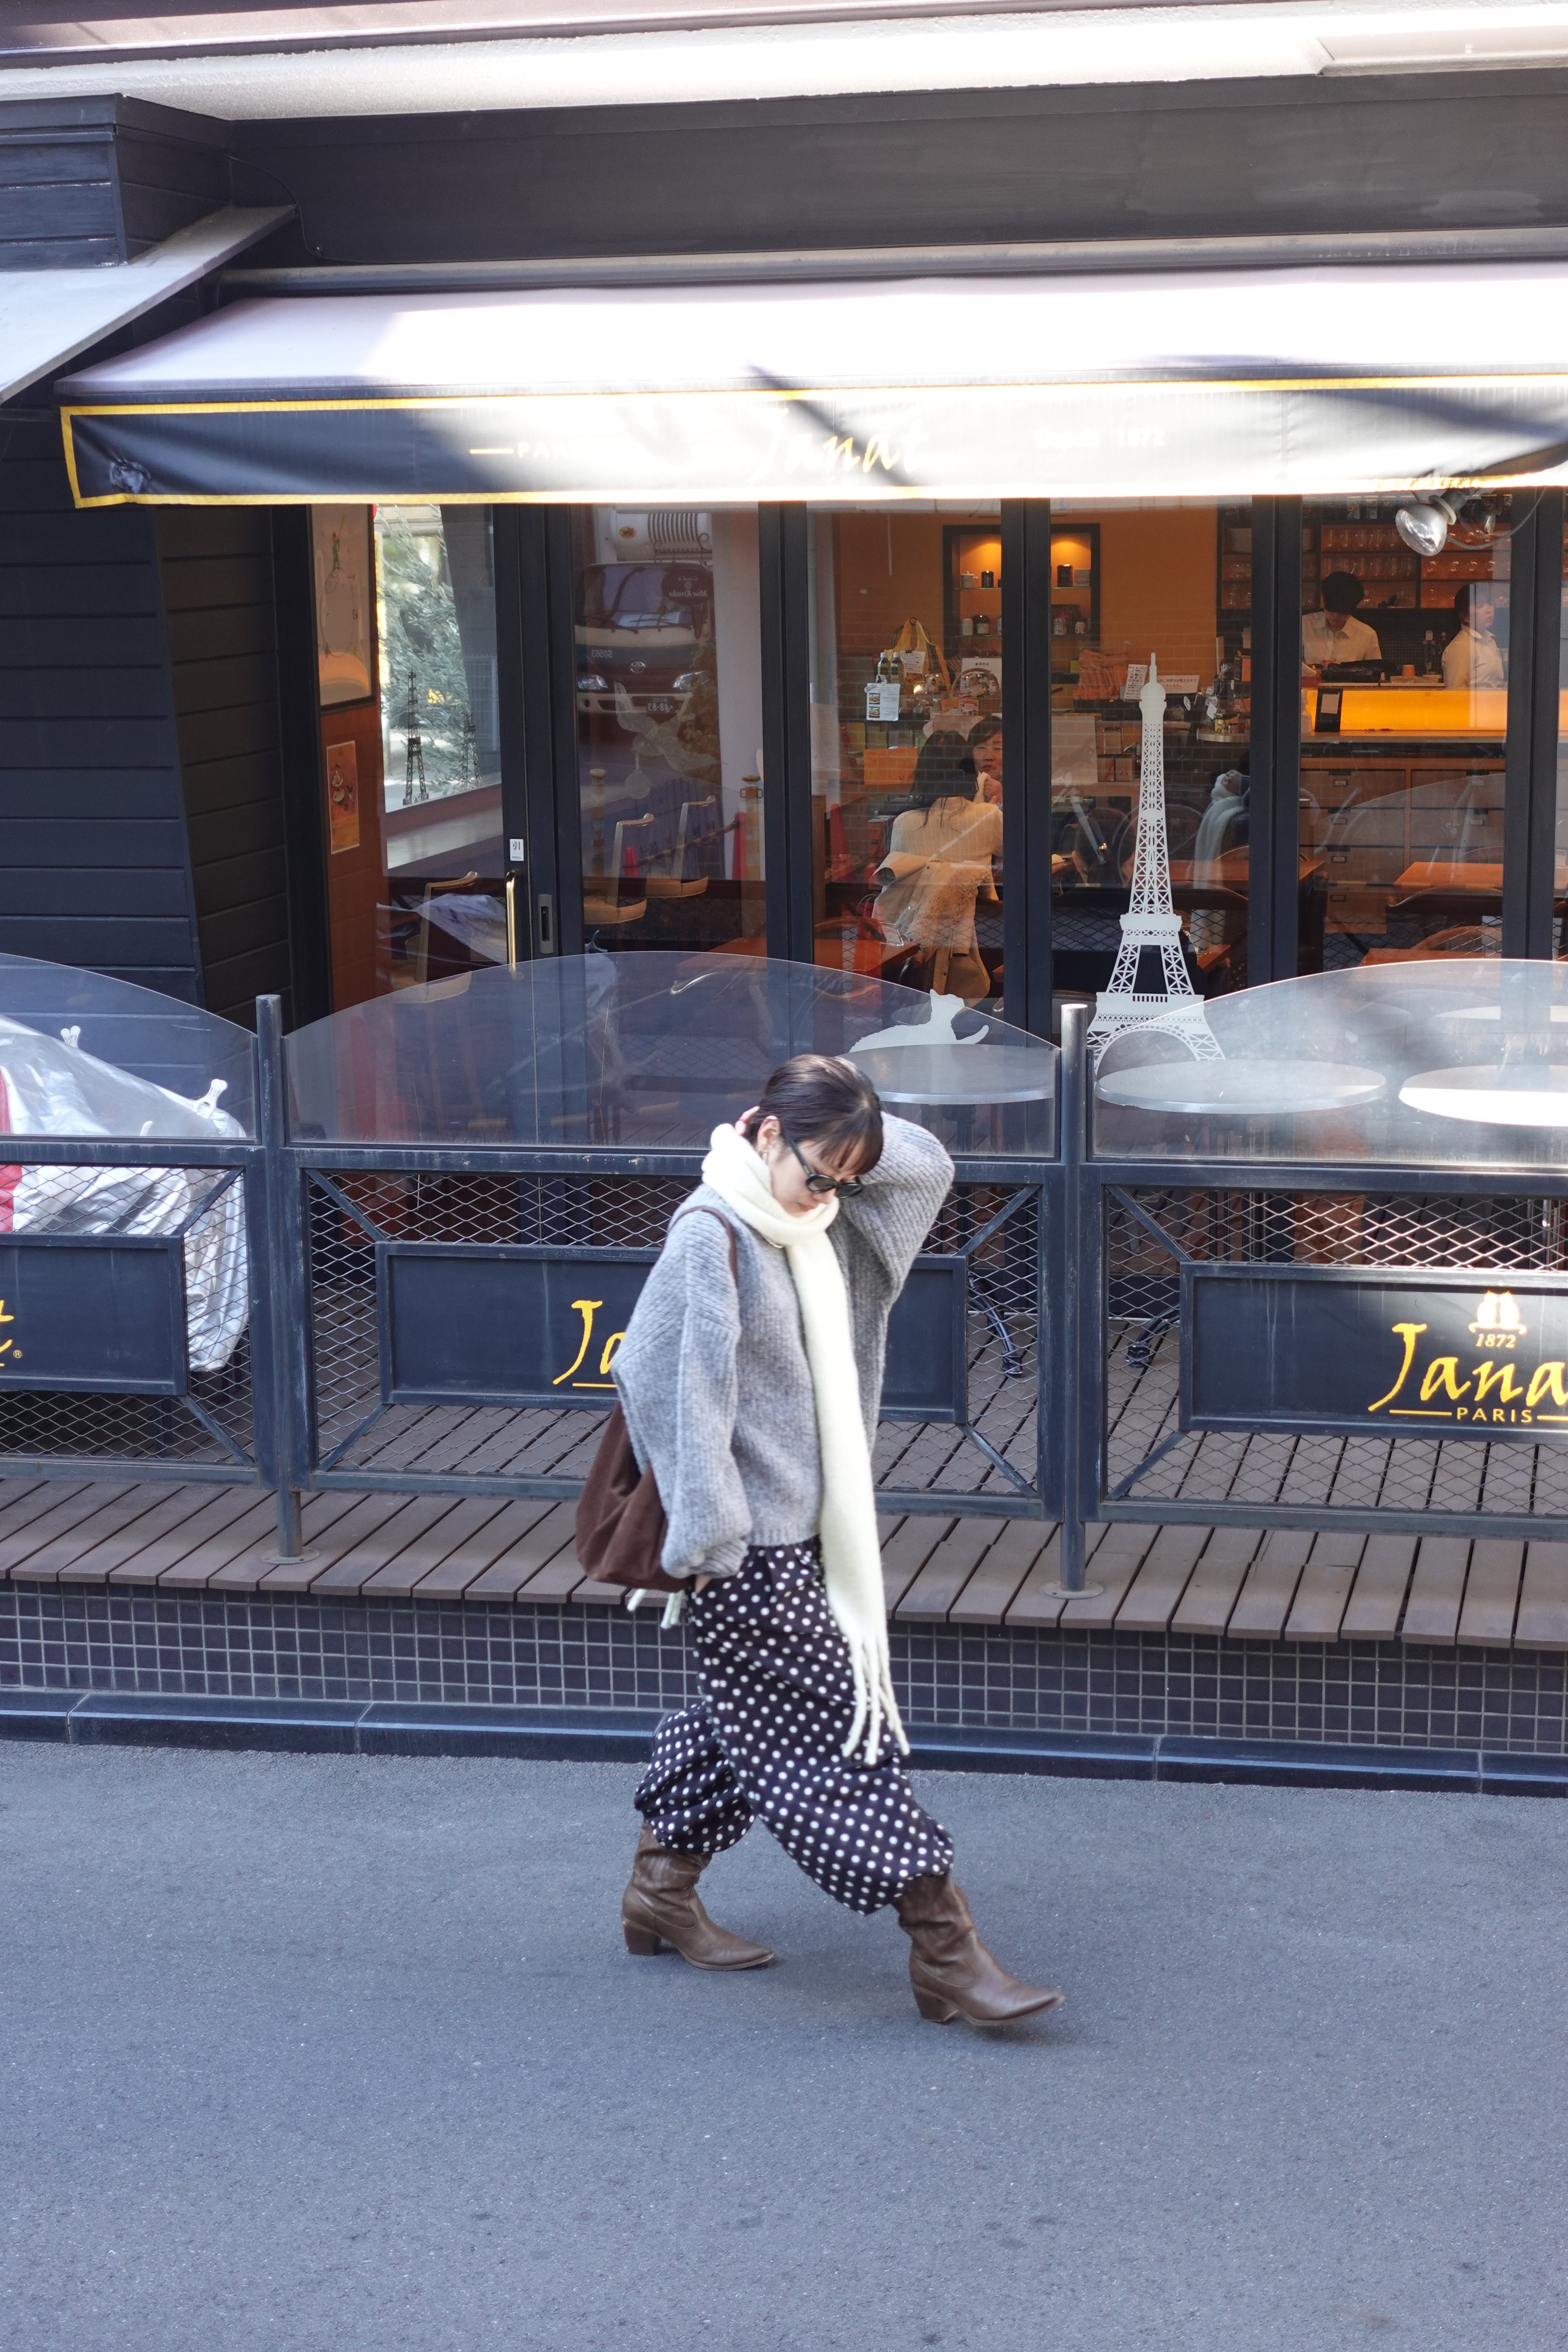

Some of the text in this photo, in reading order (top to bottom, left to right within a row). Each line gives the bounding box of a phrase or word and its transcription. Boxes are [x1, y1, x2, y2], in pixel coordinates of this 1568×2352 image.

[747, 407, 929, 485] Janat
[512, 841, 520, 850] 引
[1475, 1333, 1517, 1349] 1872
[1368, 1323, 1568, 1412] Jana
[1457, 1407, 1533, 1423] PARIS
